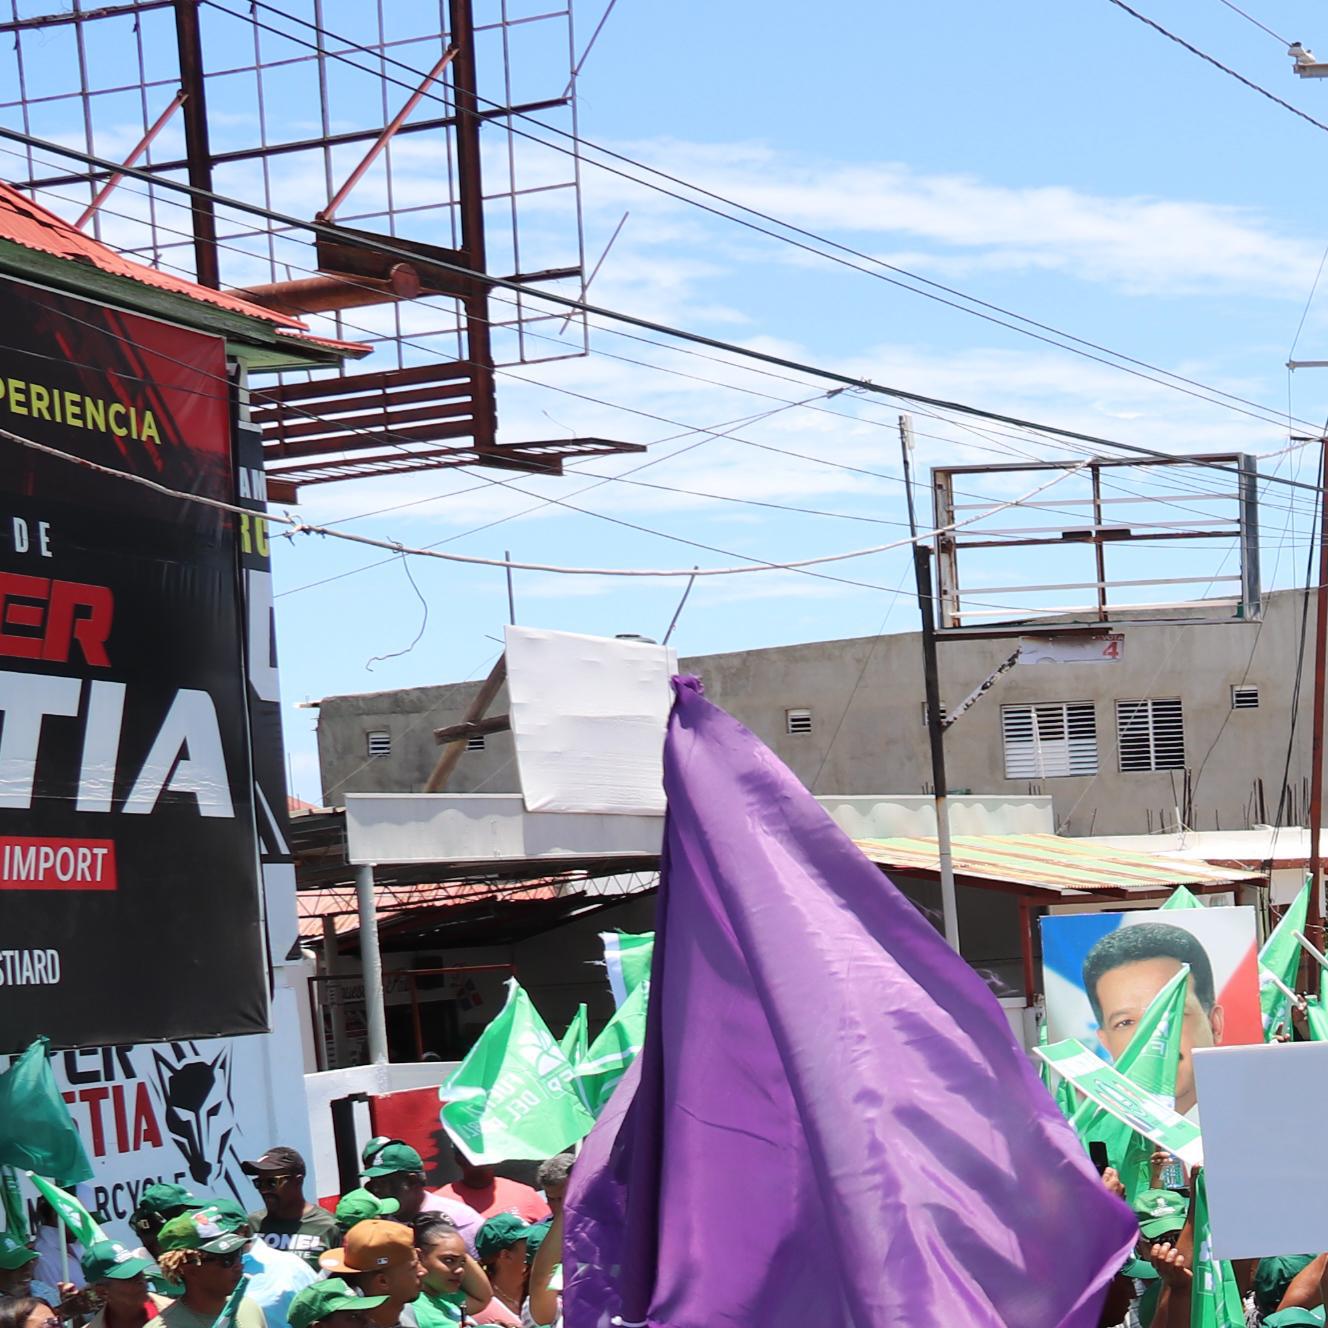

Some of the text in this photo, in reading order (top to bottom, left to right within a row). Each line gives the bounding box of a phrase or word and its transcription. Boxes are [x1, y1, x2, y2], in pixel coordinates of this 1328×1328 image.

[13, 517, 53, 557] DE
[1103, 641, 1119, 659] 4
[3, 845, 108, 883] IMPORT
[62, 1081, 163, 1157] TIA
